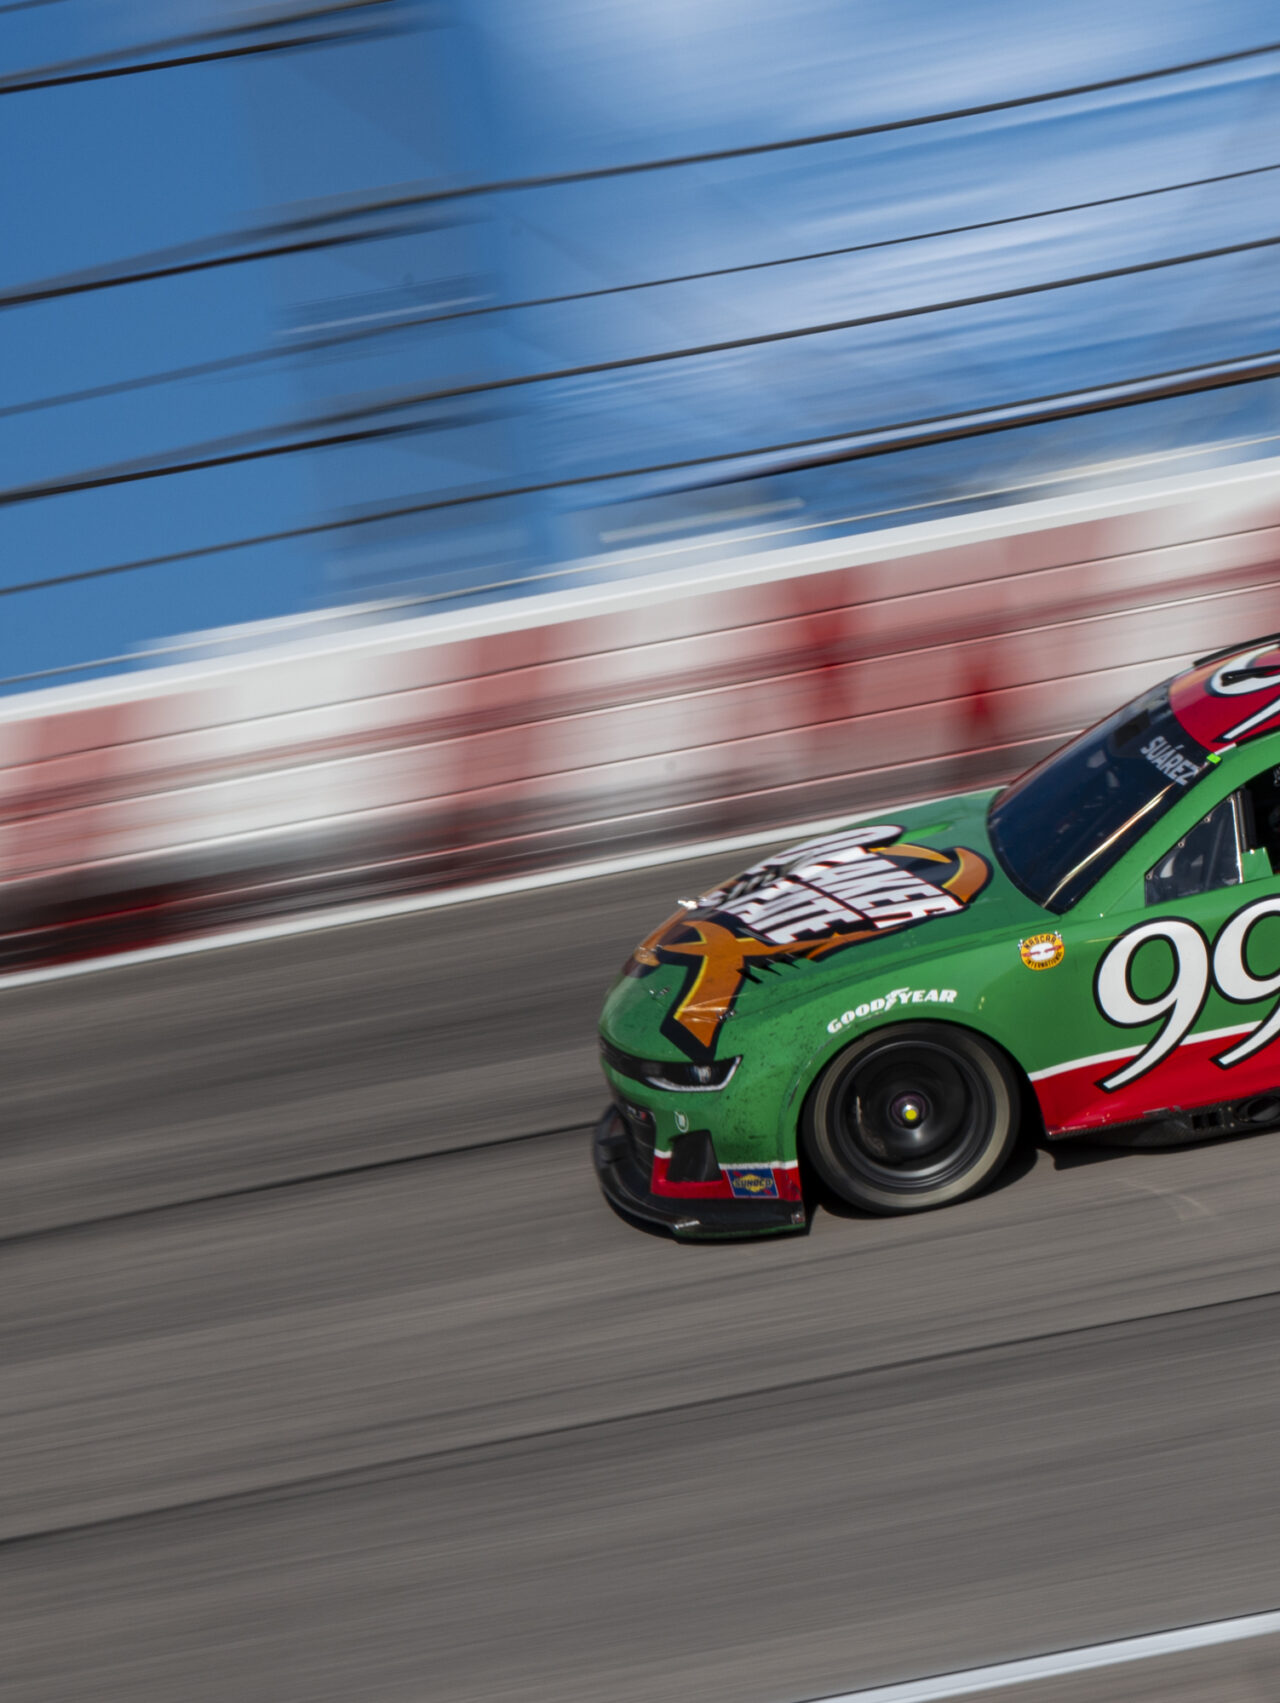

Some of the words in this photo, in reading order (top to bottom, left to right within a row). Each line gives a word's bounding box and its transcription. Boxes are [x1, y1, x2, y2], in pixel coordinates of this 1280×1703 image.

[1140, 736, 1200, 786] SUÁREZ
[742, 825, 965, 930] QUAKER
[826, 987, 958, 1034] GOODYEAR
